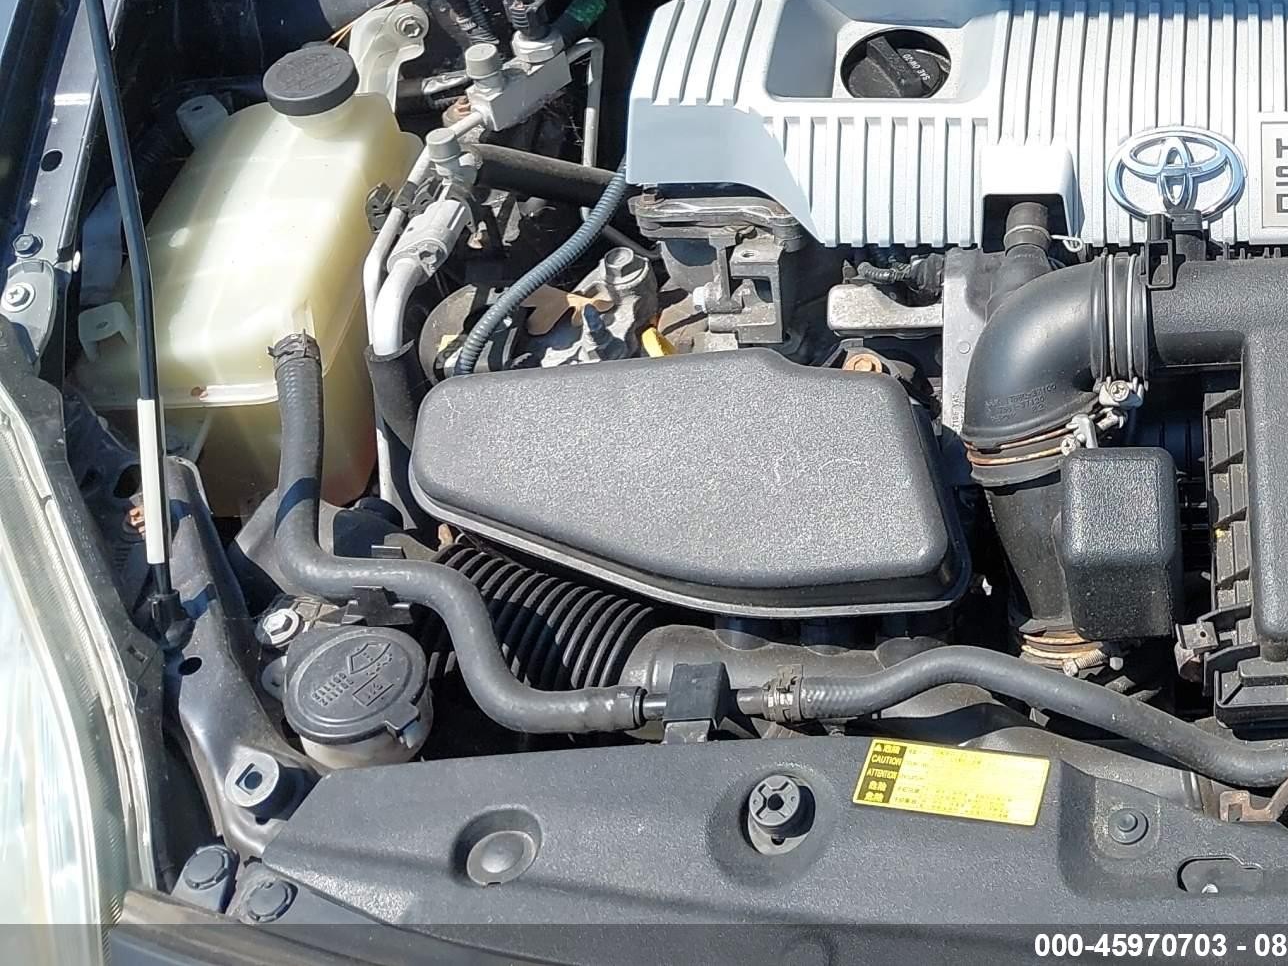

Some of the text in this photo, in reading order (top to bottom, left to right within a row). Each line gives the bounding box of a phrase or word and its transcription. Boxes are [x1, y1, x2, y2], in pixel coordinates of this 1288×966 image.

[917, 68, 930, 81] SAE
[870, 753, 902, 767] CAUTION
[866, 767, 899, 780] ATTENTION
